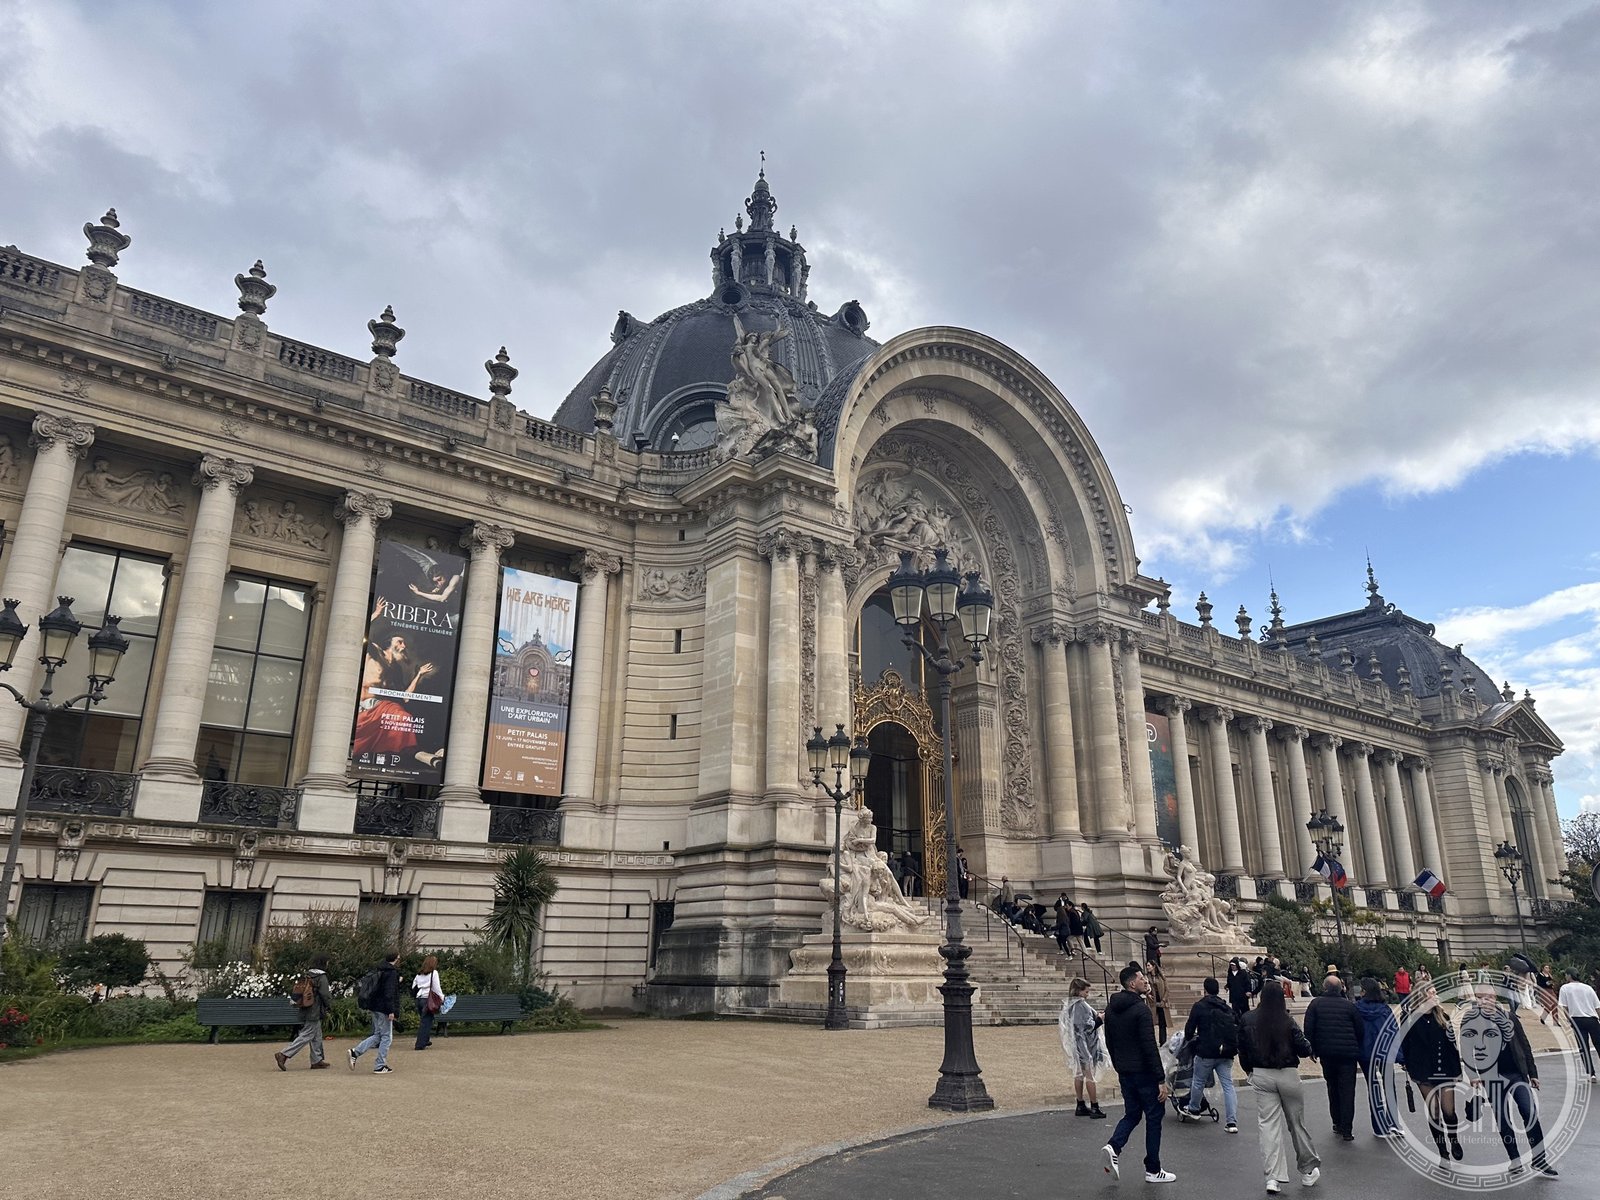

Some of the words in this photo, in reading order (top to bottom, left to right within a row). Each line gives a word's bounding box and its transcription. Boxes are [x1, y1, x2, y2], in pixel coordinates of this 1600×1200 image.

[383, 601, 453, 629] RIBERA
[390, 621, 419, 630] TÉNÈBRES
[429, 627, 453, 636] LUMIÈRE
[380, 690, 432, 700] PROCHAINEMENT
[381, 712, 400, 720] PETIT
[402, 715, 425, 724] PALAIS
[500, 705, 515, 713] UNE
[516, 707, 559, 719] EXPLORATION
[527, 715, 551, 724] URBAIN
[507, 728, 526, 737] PETIT
[526, 731, 548, 740] PALAIS
[522, 738, 547, 746] NOVEMBRE
[525, 744, 546, 752] GRATUITE
